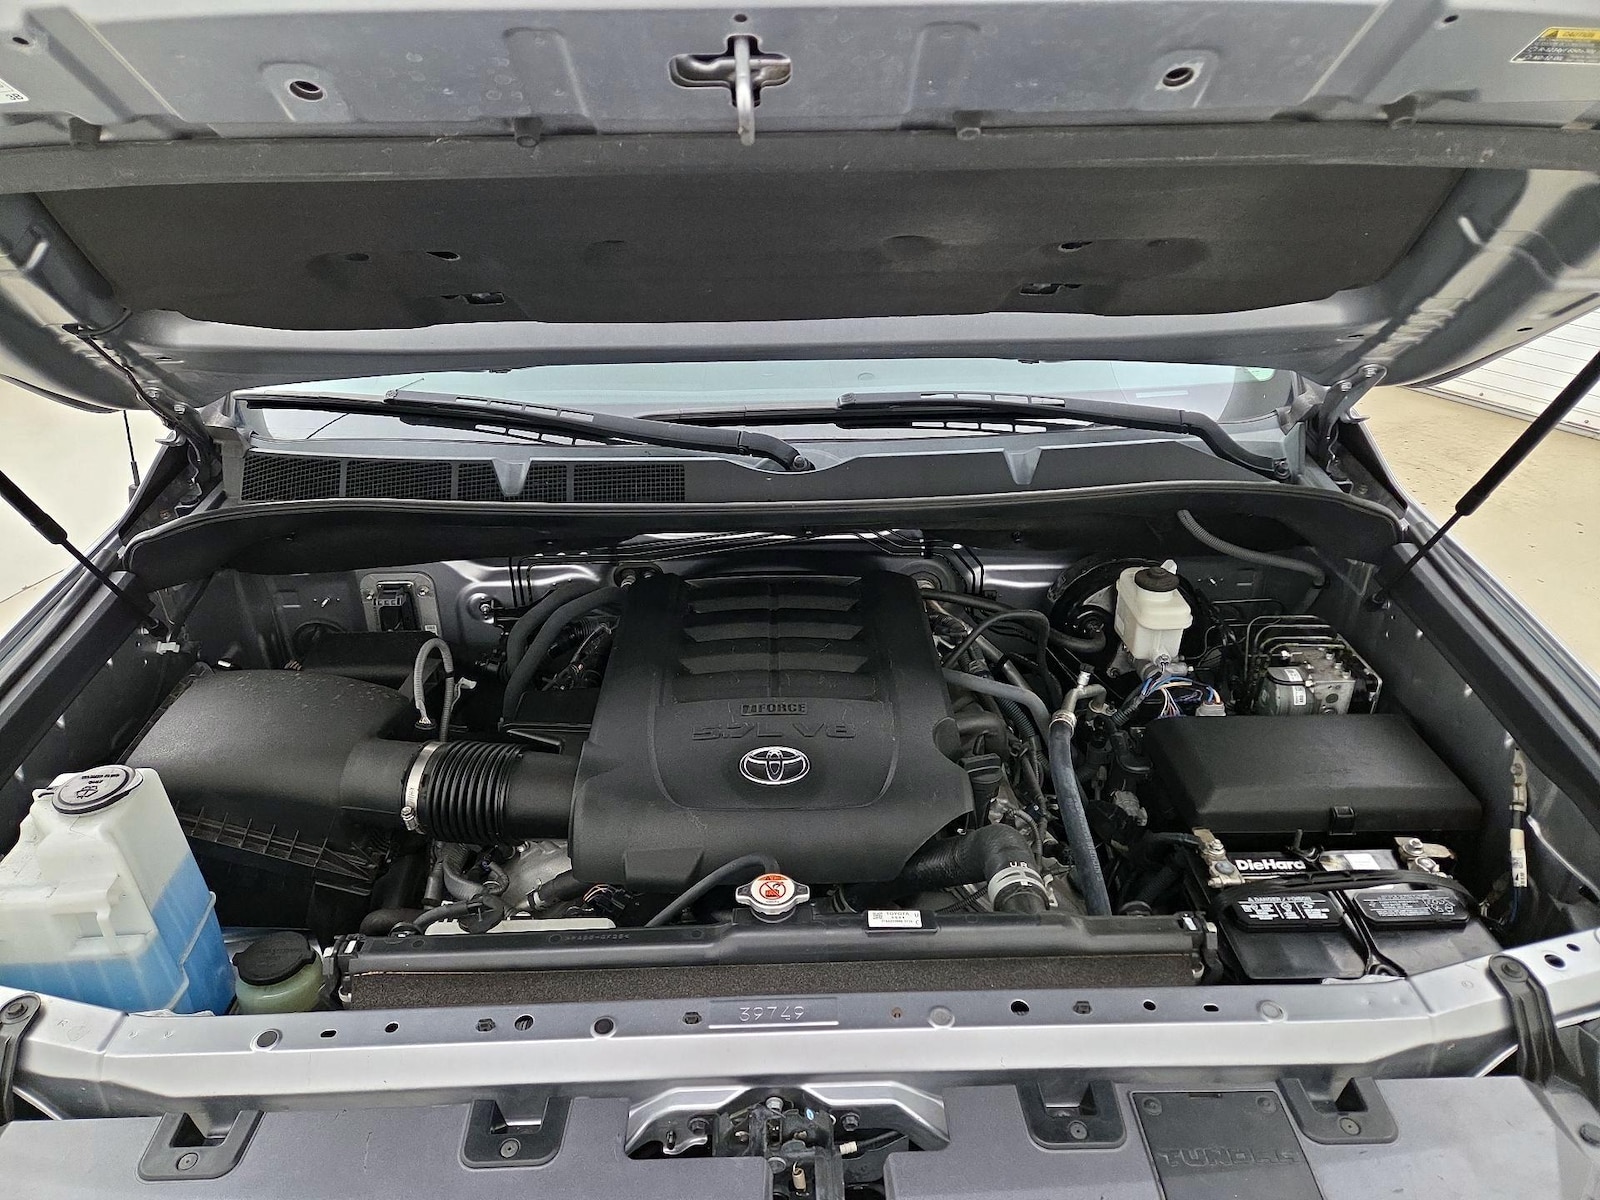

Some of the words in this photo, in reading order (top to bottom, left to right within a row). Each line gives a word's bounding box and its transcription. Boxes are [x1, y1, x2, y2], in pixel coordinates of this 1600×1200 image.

[791, 722, 857, 739] V8
[1235, 858, 1306, 871] DieHard
[739, 1005, 805, 1022] 39749
